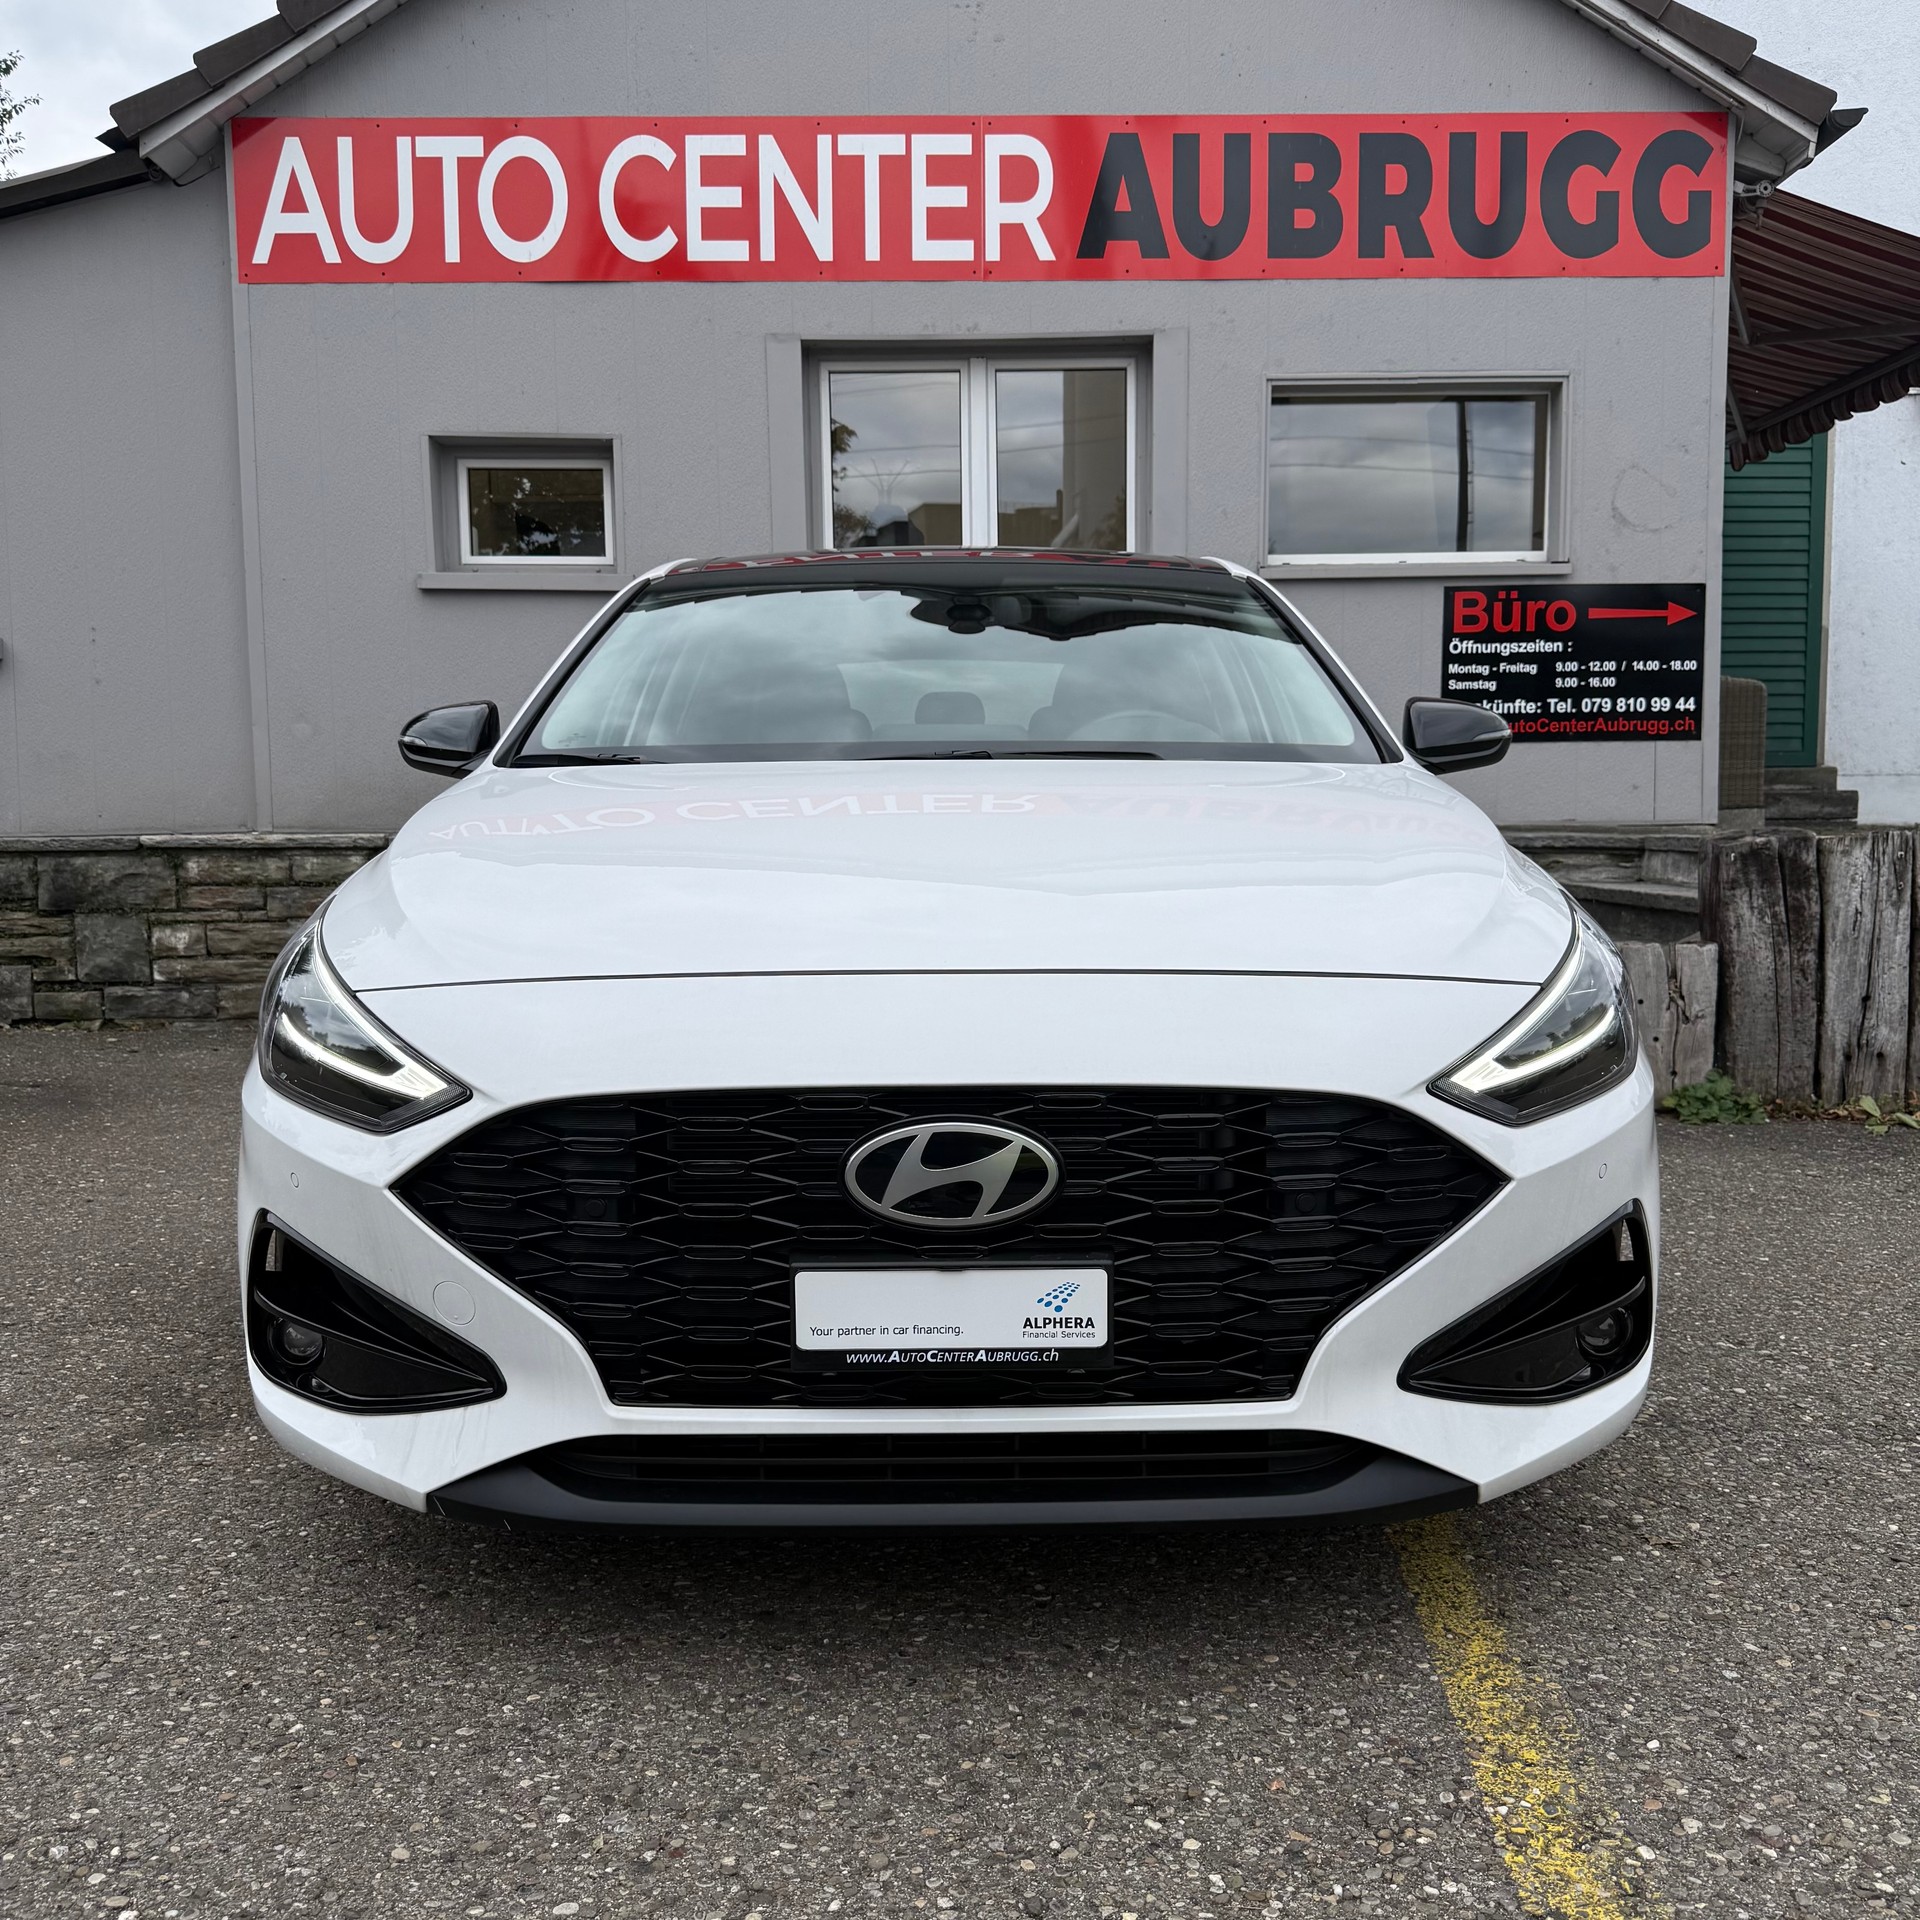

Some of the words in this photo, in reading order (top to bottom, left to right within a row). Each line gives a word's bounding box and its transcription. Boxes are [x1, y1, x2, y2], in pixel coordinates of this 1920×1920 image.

[252, 135, 569, 264] AUTO
[598, 133, 1056, 263] CENTER
[1076, 129, 1715, 261] AUBRUGG
[1452, 590, 1577, 634] Büro
[1448, 637, 1563, 656] Öffnungszeiten
[1448, 663, 1490, 676] Montag
[1499, 662, 1538, 675] Freitag
[1555, 661, 1579, 672] 9.00
[1587, 660, 1617, 672] 12.00
[1631, 660, 1660, 671] 14.00
[1669, 659, 1698, 671] 18.00
[1447, 679, 1497, 692] Samstag
[1555, 677, 1578, 688] 9.00
[1587, 676, 1616, 688] 16.00
[1476, 698, 1542, 715] künfte:
[1546, 698, 1577, 714] Tel.
[1581, 697, 1612, 713] 079
[1615, 696, 1647, 713] 810
[1650, 696, 1671, 712] 99
[1674, 696, 1696, 712] 44
[1507, 717, 1696, 735] utoCenterAubrugg.ch
[809, 1326, 835, 1337] Your
[837, 1326, 877, 1338] partner
[879, 1325, 889, 1335] in
[892, 1326, 909, 1335] car
[912, 1324, 964, 1337] financing.
[1022, 1316, 1096, 1329] ALPHERA
[1022, 1330, 1058, 1339] Financial
[1060, 1330, 1096, 1339] Services
